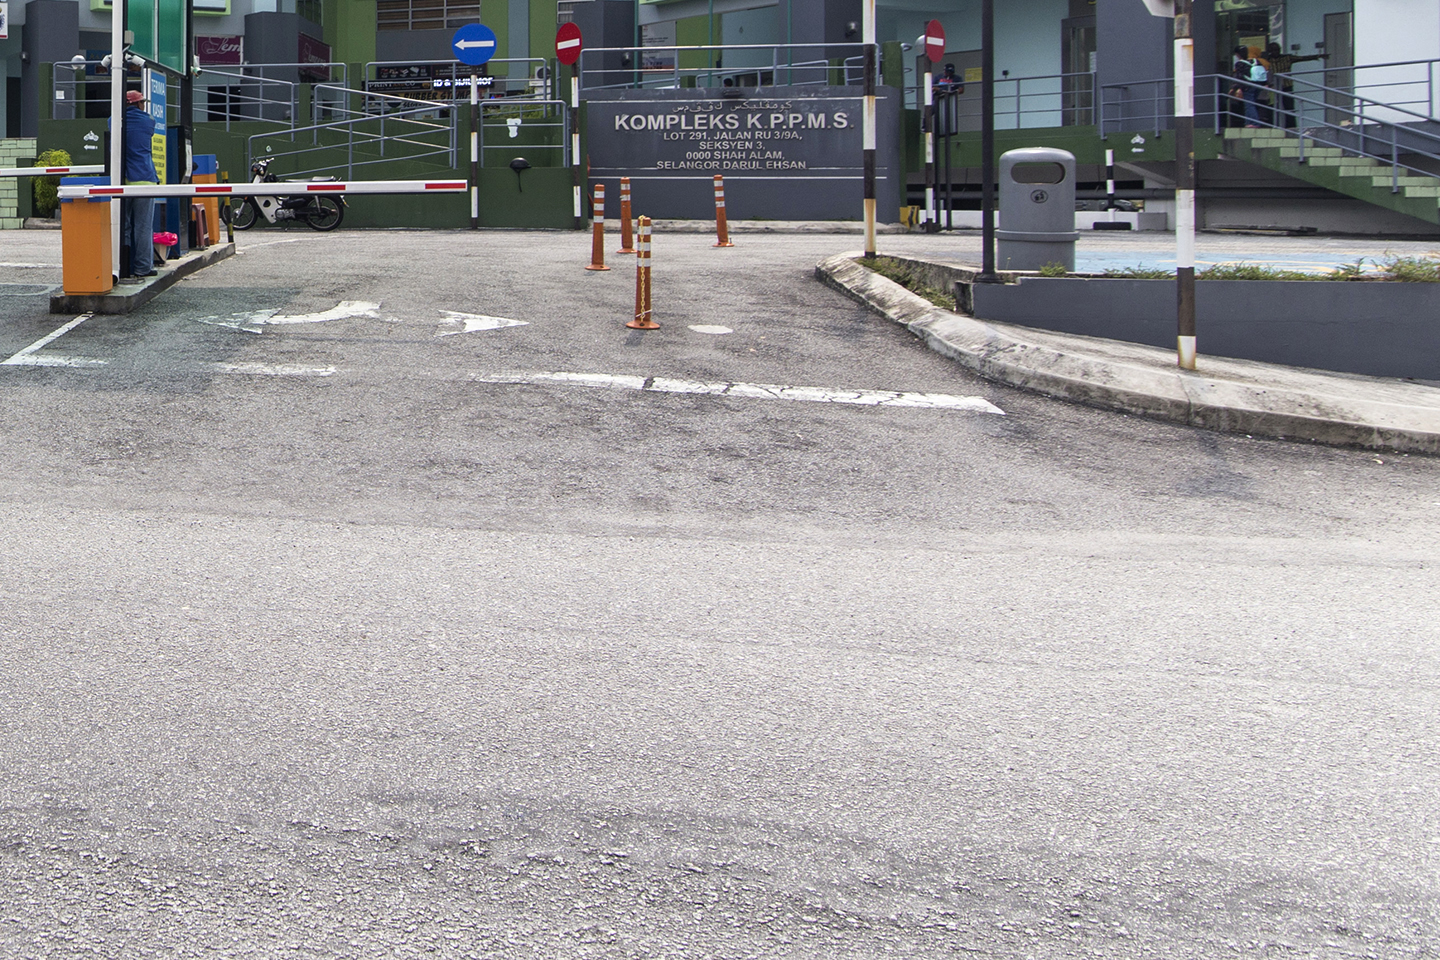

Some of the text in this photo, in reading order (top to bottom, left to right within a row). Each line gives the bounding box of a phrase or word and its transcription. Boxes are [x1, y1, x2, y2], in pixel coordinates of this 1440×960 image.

[151, 78, 166, 97] TERIMA
[152, 102, 164, 118] KASIH
[614, 113, 740, 131] KOMPLEKS
[663, 132, 686, 140] LOT
[713, 131, 752, 140] JALAN
[755, 132, 772, 140] RU
[773, 131, 803, 141] 3/9A,
[699, 141, 766, 150] SEKSYEN 3,
[686, 151, 785, 160] 0000 SHAH ALAM,
[656, 160, 808, 170] SELANGOR DARUL EHSAN
